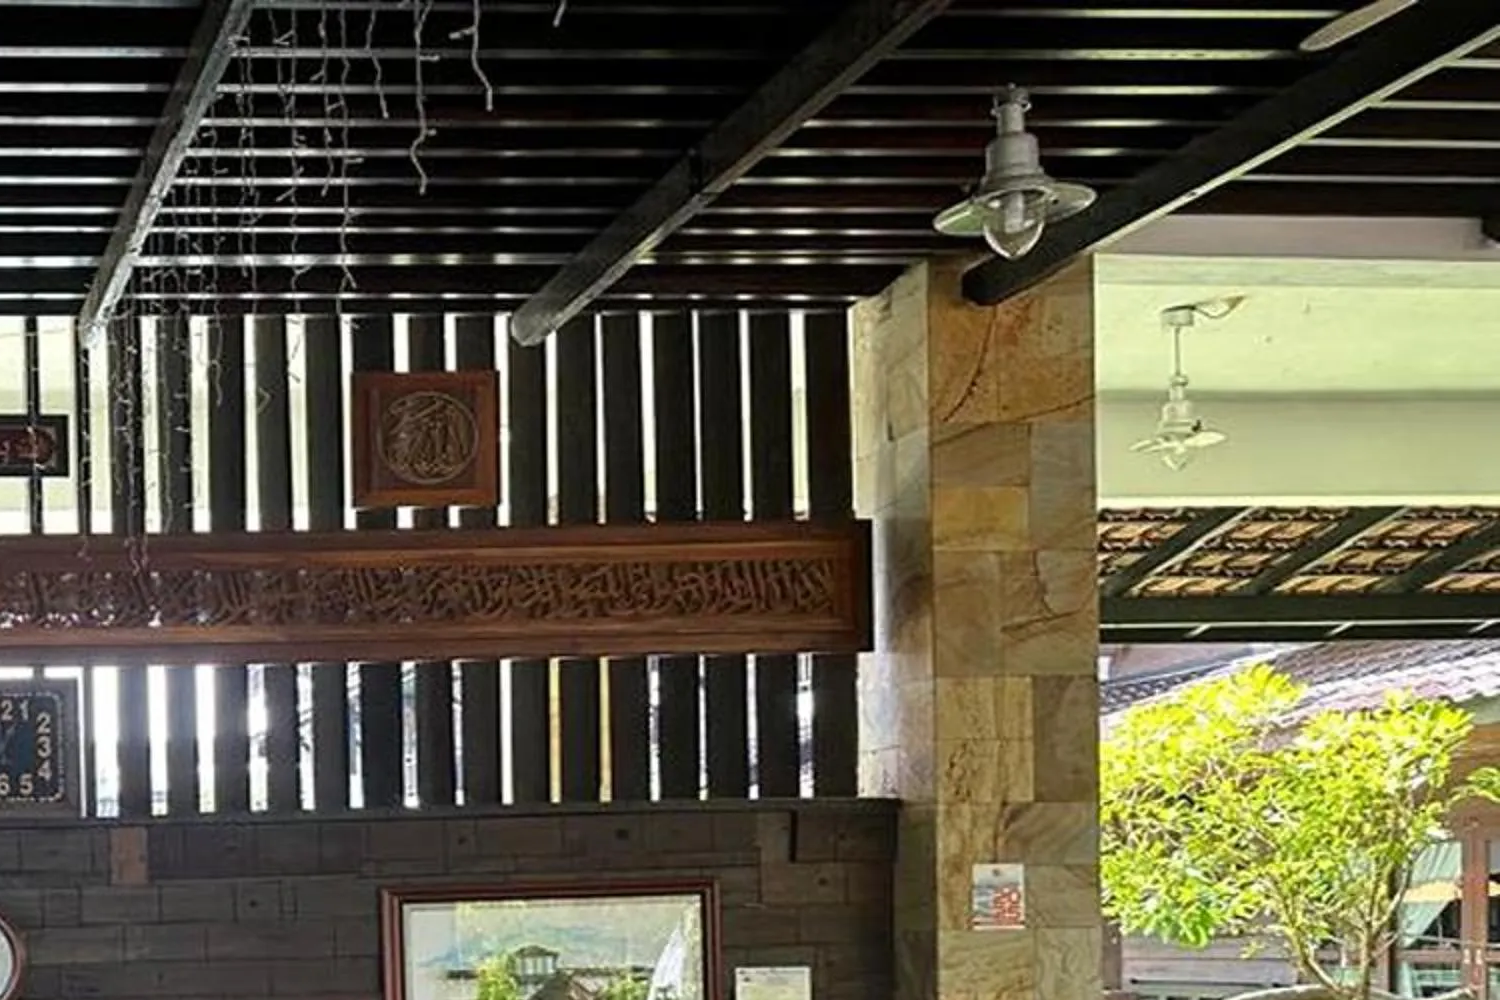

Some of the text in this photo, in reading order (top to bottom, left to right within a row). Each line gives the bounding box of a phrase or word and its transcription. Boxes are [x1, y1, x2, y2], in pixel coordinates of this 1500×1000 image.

[20, 700, 29, 721] 1
[36, 712, 51, 735] 2
[37, 736, 51, 758] 3
[37, 760, 52, 781] 4
[19, 773, 33, 796] 5
